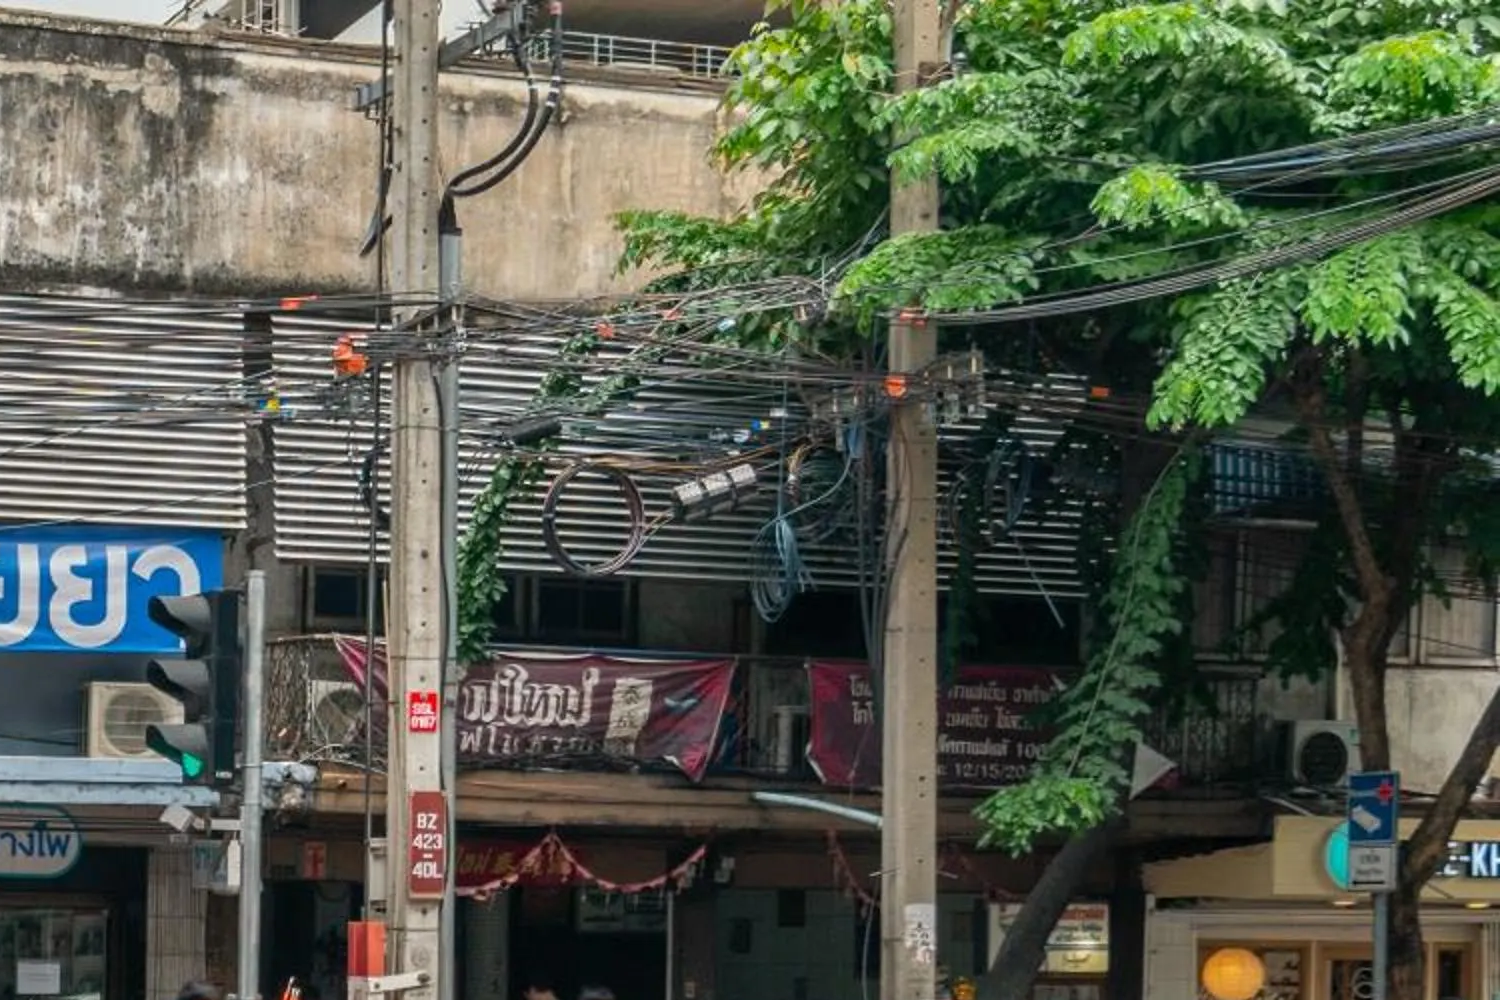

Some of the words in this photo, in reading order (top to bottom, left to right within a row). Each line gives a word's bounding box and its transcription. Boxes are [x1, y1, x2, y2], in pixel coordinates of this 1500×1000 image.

[417, 813, 438, 829] BZ
[413, 834, 443, 850] 423
[412, 862, 443, 879] 4DL
